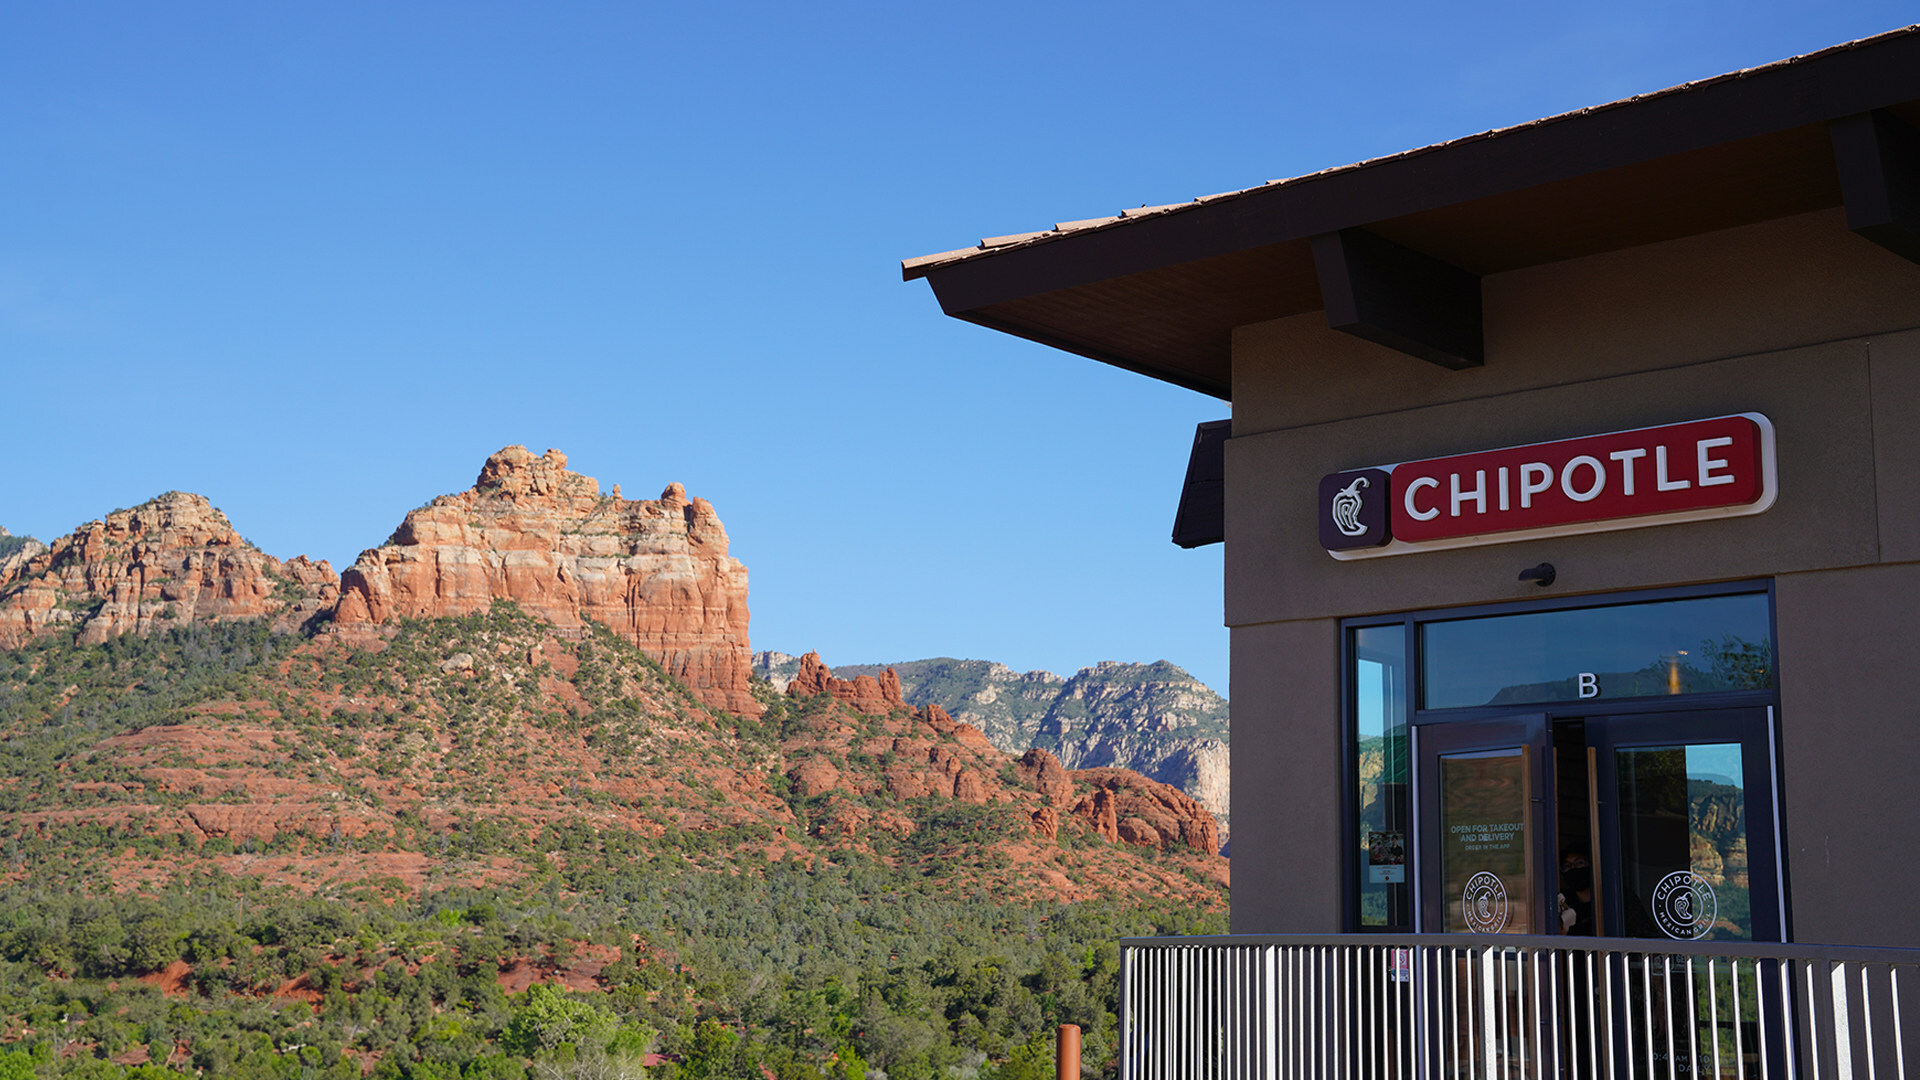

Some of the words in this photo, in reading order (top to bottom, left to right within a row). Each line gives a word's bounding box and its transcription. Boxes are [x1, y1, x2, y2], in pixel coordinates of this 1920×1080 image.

[1404, 436, 1735, 521] CHIPOTLE
[1579, 672, 1598, 698] B
[1451, 825, 1471, 833] OPEN
[1473, 825, 1488, 833] FOR
[1489, 823, 1524, 832] TAKEOUT
[1461, 834, 1477, 842] AND
[1478, 832, 1515, 842] DELIVERY
[1466, 876, 1504, 900] CHIPOTLE
[1657, 875, 1712, 902] CHIPOTLE
[1467, 910, 1490, 933] MEXICAN
[1659, 912, 1692, 935] MEXICAN
[1693, 912, 1711, 932] GRILL
